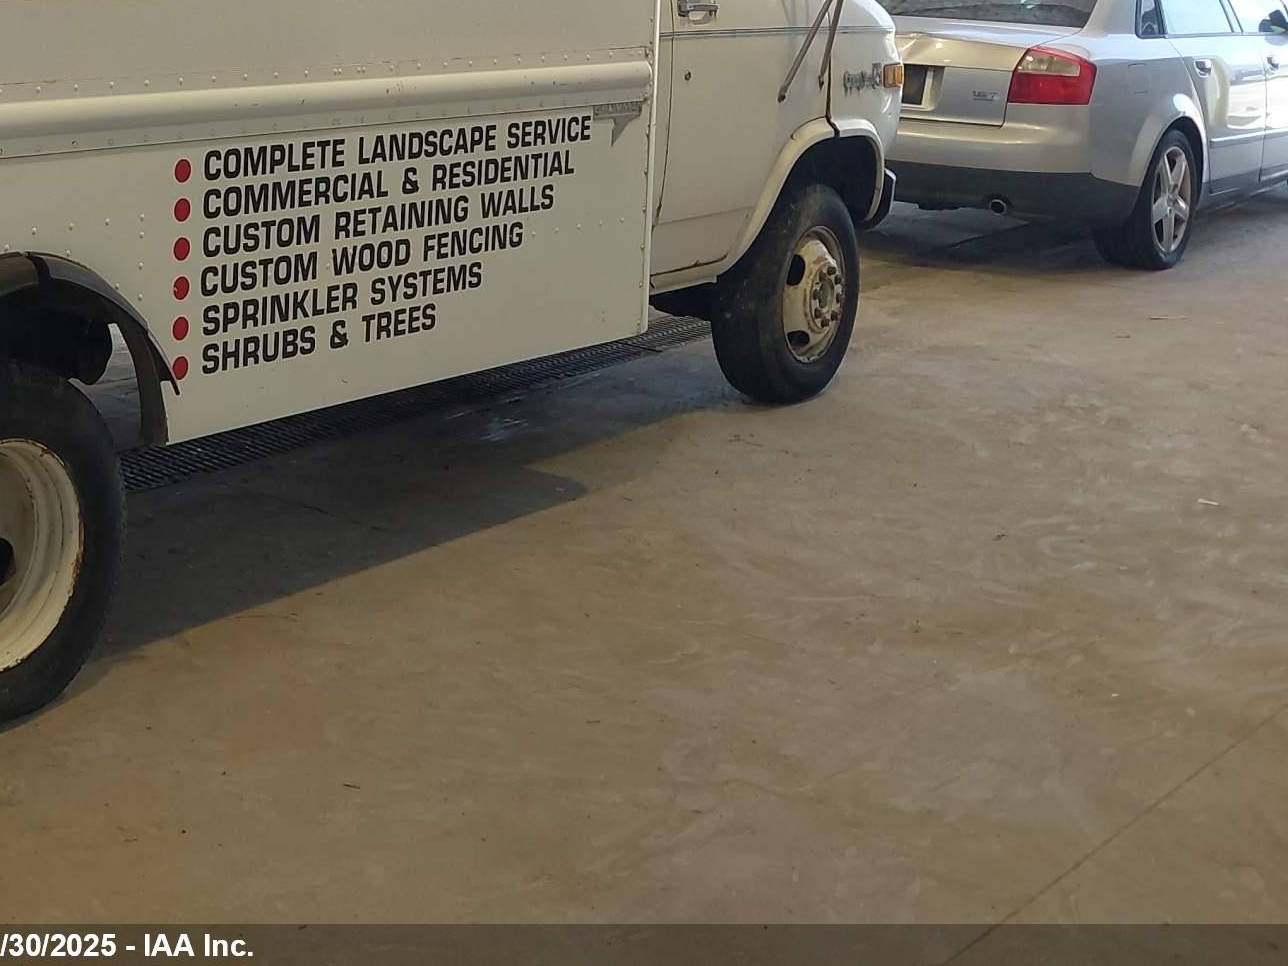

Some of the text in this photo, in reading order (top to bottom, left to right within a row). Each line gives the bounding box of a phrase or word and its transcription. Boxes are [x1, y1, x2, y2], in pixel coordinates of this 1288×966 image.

[203, 149, 575, 220] COMMERCIAL & RESIDENTIAL
[205, 115, 592, 181] COMPLETE LANDSCAPE SERVICE
[202, 184, 554, 258] CUSTOM RETAINING WALLS
[200, 221, 524, 297] CUSTOM WOOD FENCING
[202, 261, 482, 336] SPRINKLER SYSTEMS
[201, 303, 436, 375] SHRUBS & TREES
